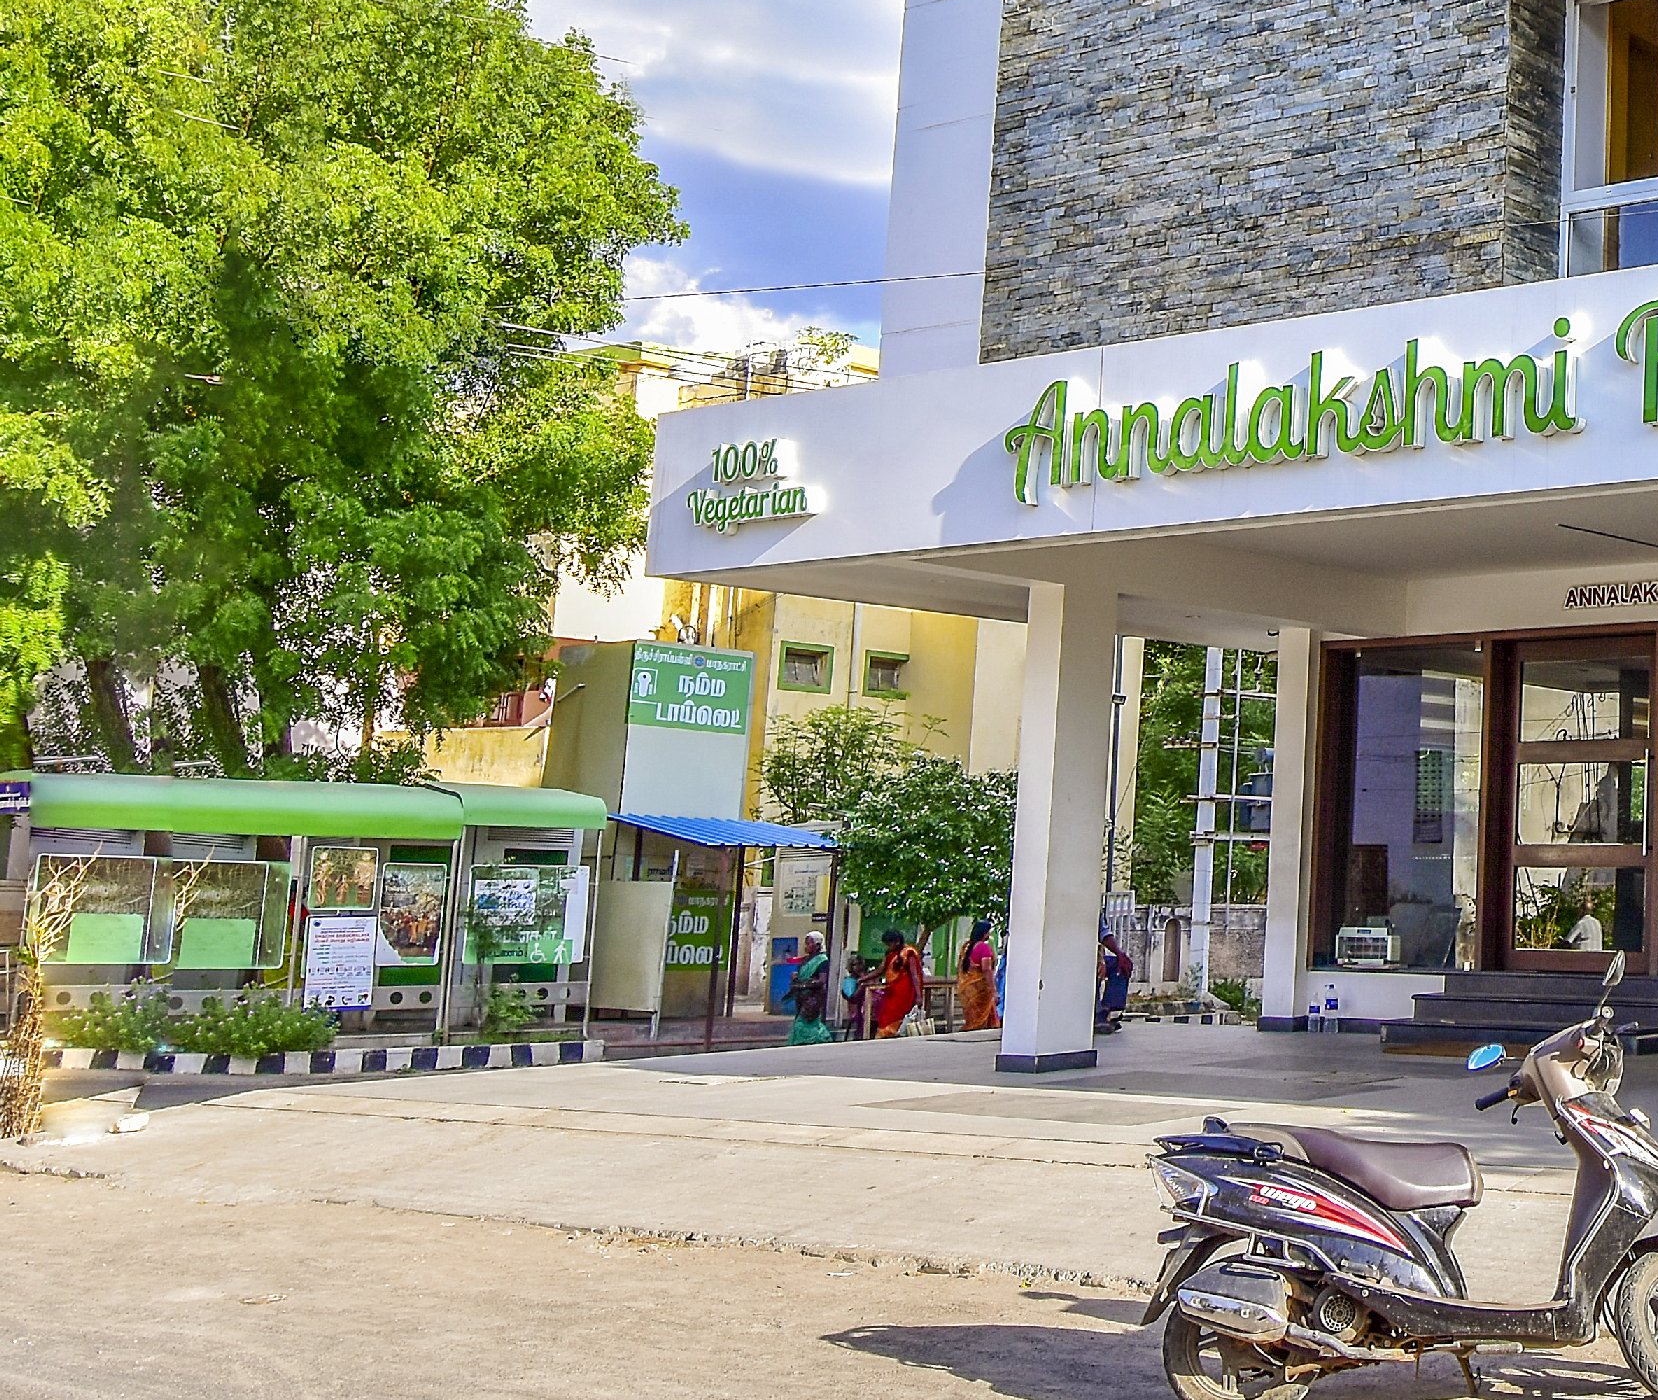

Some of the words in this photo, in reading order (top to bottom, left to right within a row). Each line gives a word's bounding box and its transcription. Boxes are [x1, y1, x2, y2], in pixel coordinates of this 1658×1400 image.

[1004, 316, 1582, 506] Annalakshmi
[710, 438, 778, 482] 100%
[686, 482, 808, 534] Vegetarian
[678, 672, 726, 698] நம்ம
